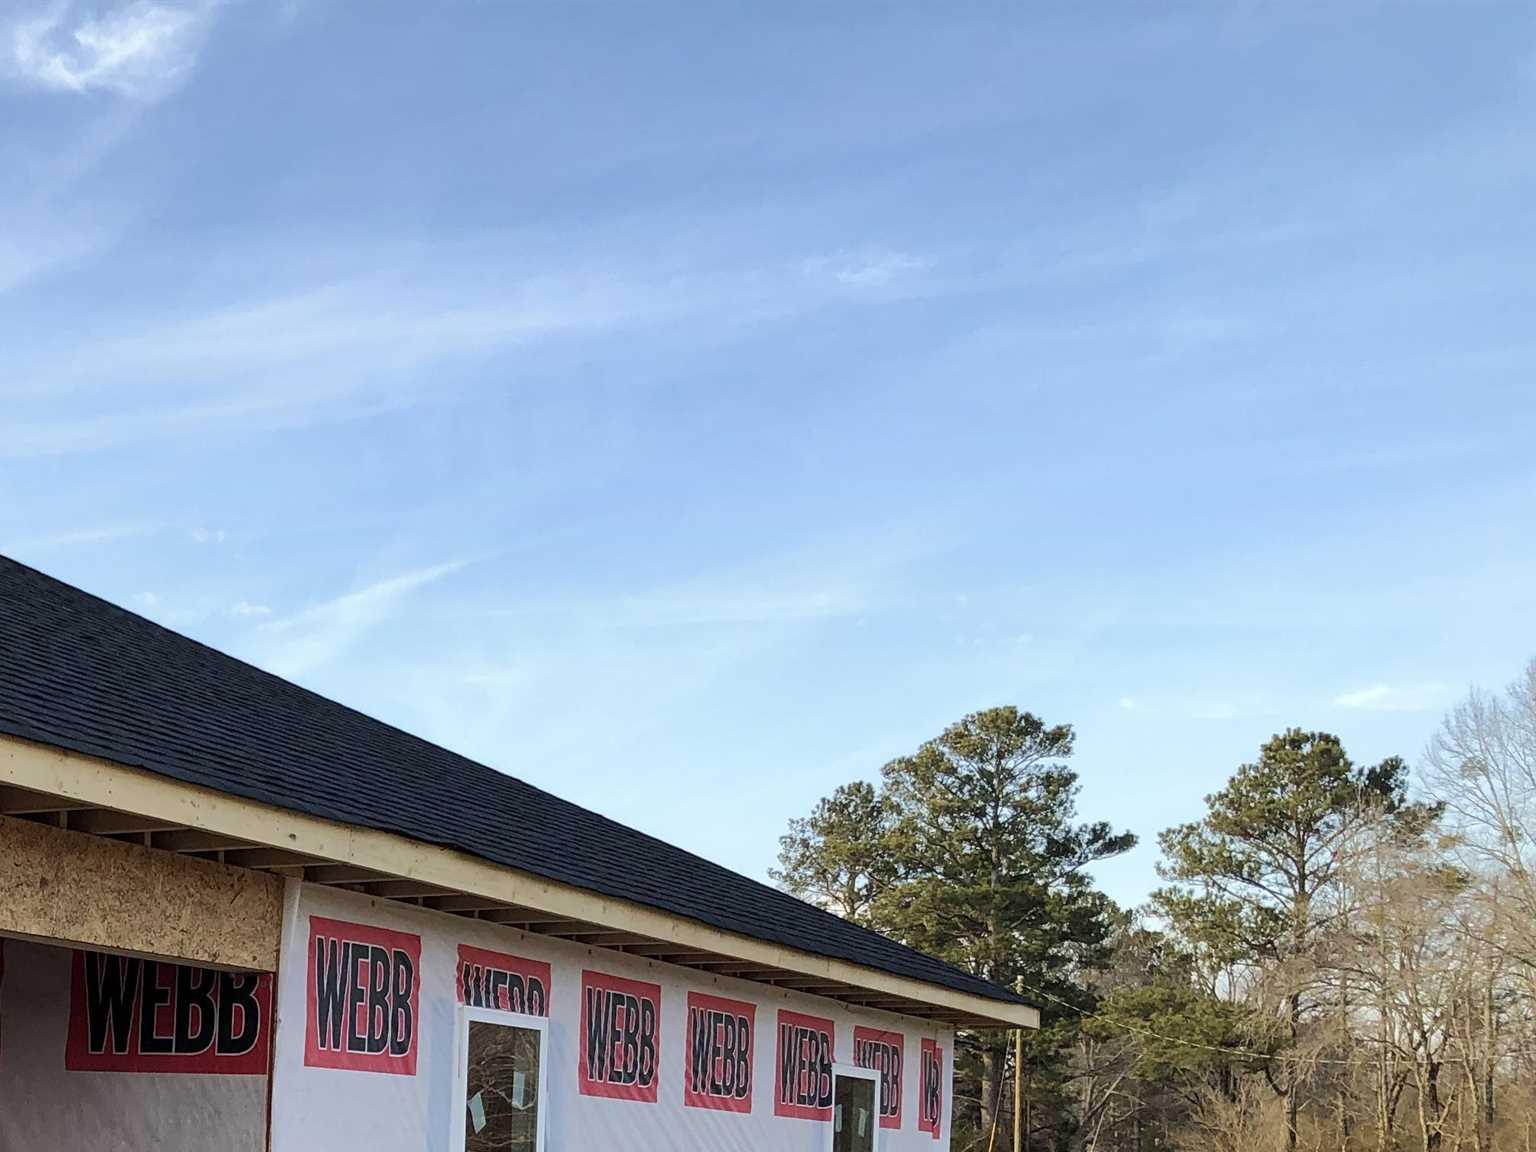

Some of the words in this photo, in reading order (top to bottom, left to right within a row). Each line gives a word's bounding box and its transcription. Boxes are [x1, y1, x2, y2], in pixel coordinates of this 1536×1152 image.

[83, 950, 261, 1056] WEBB
[314, 935, 414, 1057] WEBB
[586, 984, 657, 1087] WEBB
[690, 1006, 751, 1099] WEBB
[780, 1023, 833, 1110] WEBB
